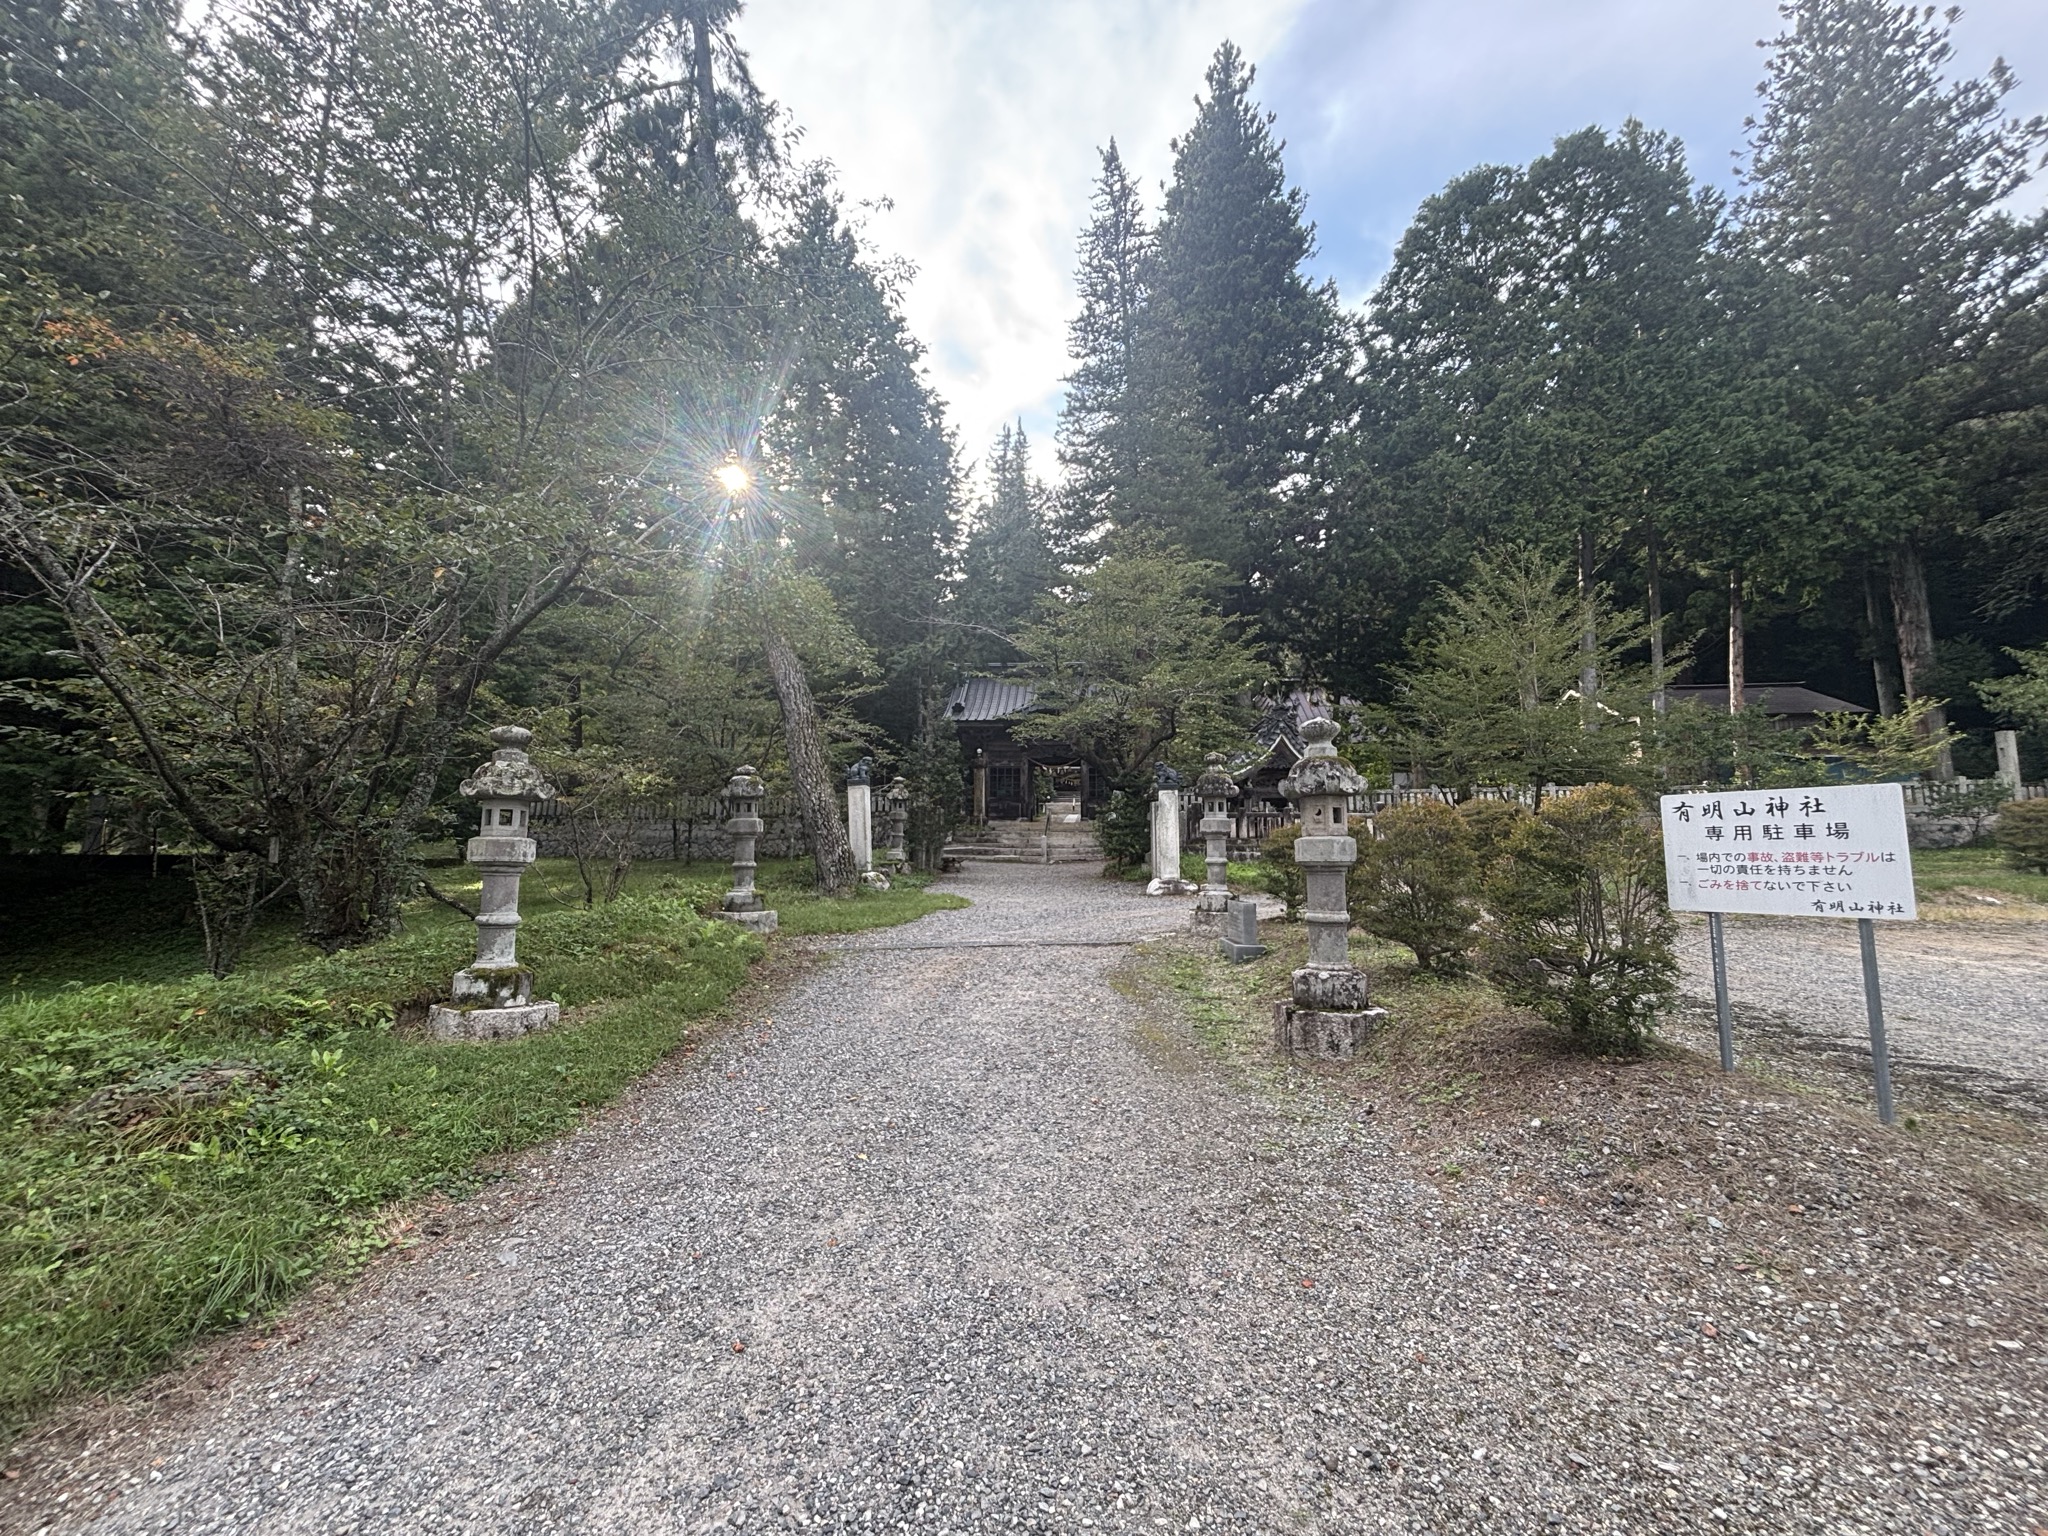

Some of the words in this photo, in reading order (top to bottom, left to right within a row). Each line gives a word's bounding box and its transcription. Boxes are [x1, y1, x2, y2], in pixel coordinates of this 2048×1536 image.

[1671, 795, 1827, 823] 有明山神社
[1704, 822, 1850, 842] 専用駐車場
[1697, 864, 1854, 877] 一切の責任を持ちません
[1810, 898, 1905, 915] 有明山神社
